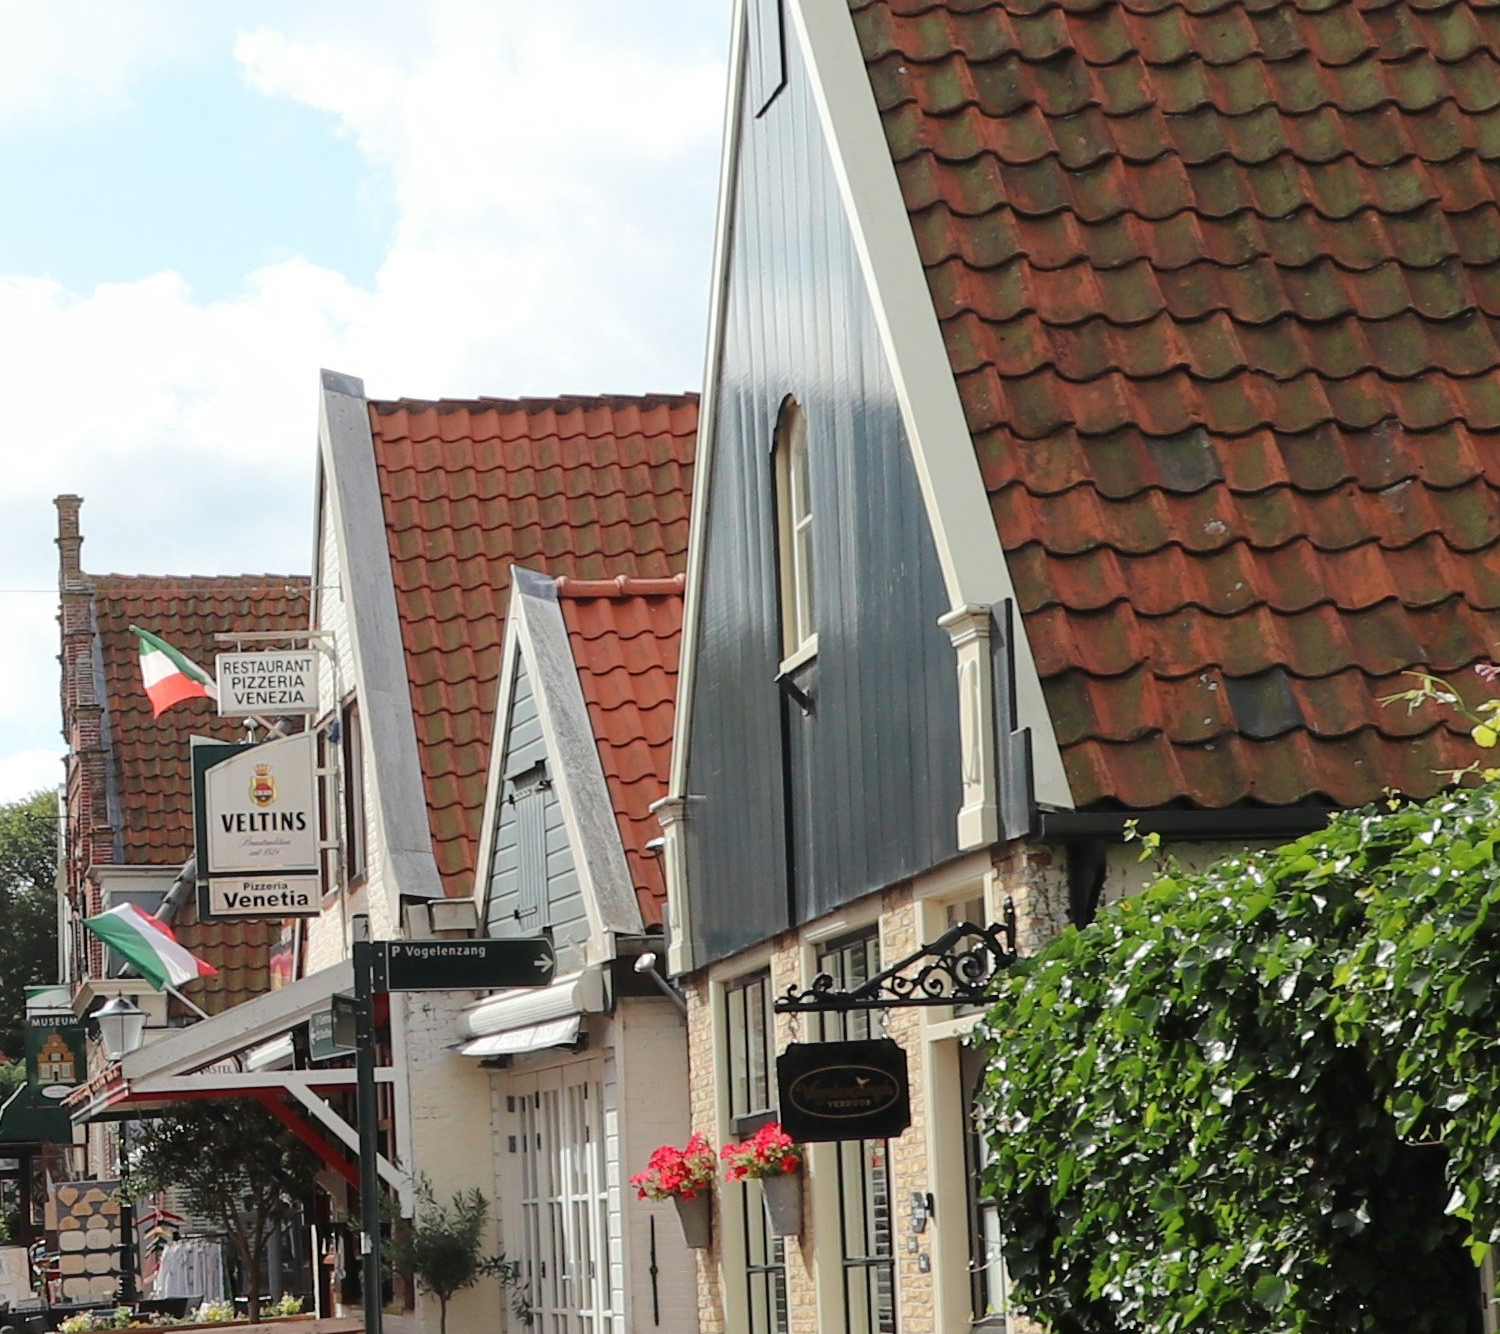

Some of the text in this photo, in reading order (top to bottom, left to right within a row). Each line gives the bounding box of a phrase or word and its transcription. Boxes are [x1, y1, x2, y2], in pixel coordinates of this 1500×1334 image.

[223, 659, 312, 675] RESTAURANT
[232, 675, 305, 689] PIZZERIA
[234, 690, 305, 705] VENEZIA
[221, 812, 307, 833] VELTINS
[243, 882, 288, 891] Pizzeria
[223, 890, 309, 908] Venetia
[405, 945, 486, 959] Vogelenzang
[31, 1017, 79, 1027] MUSEUM
